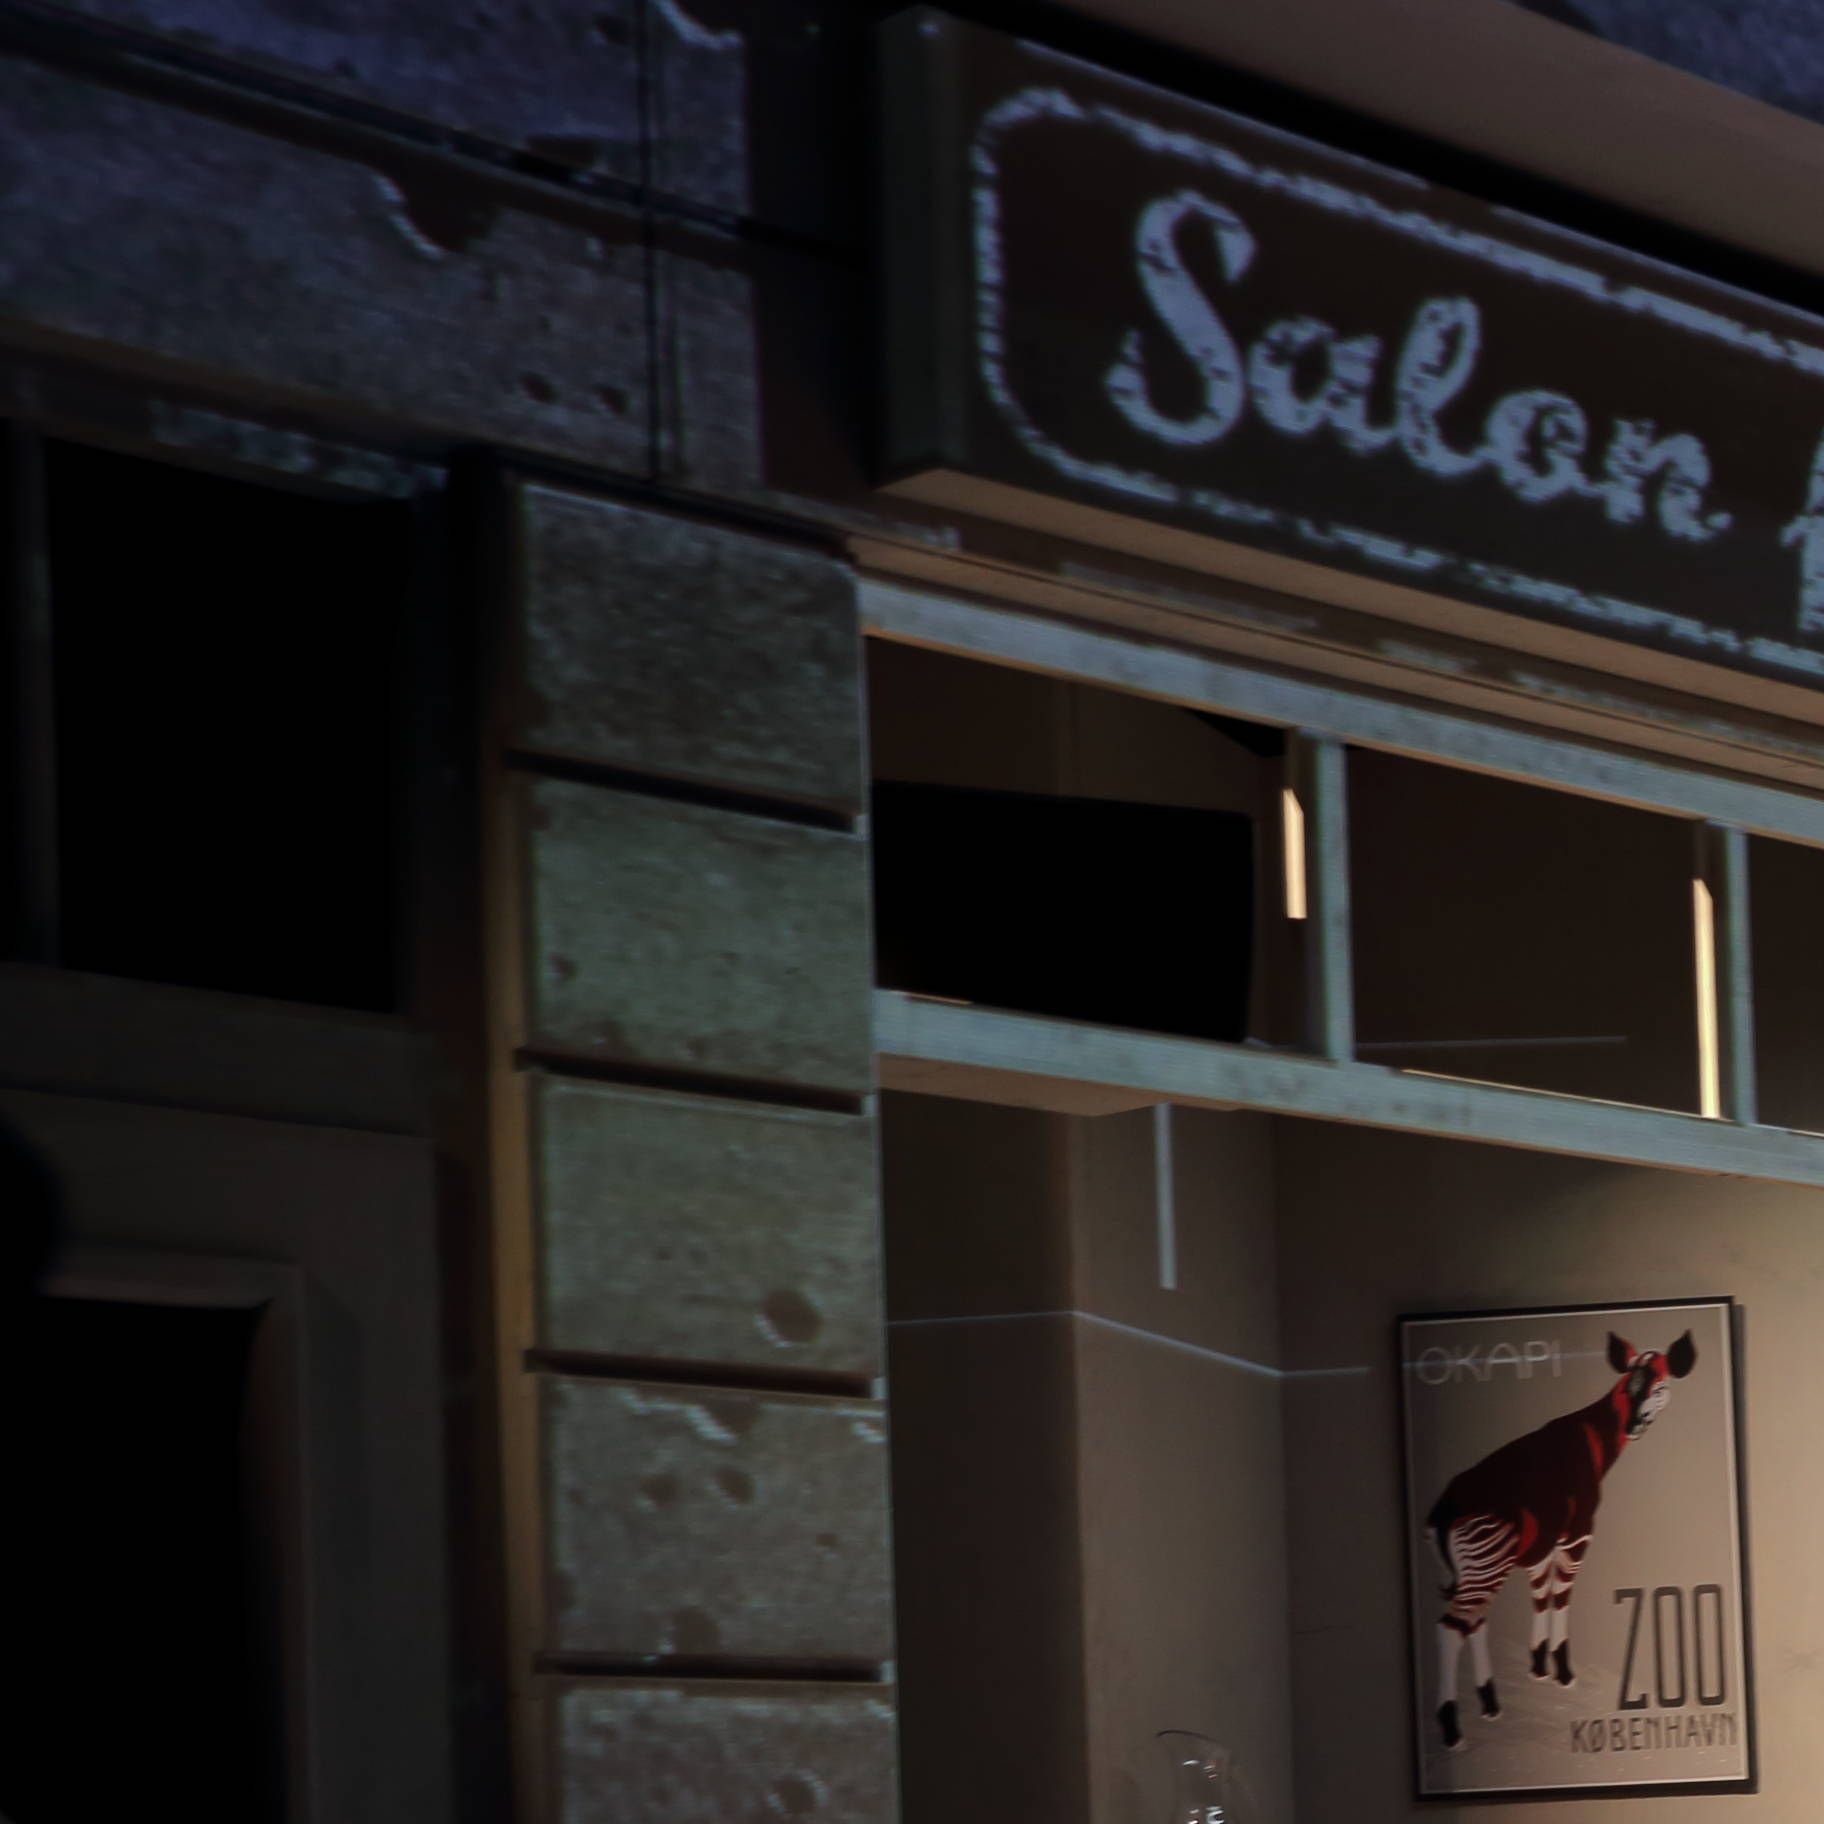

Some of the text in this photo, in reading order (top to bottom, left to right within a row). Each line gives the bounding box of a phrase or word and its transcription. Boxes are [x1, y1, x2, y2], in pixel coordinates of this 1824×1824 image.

[1103, 188, 1732, 542] Salon
[1416, 1340, 1562, 1385] OKAPI
[1614, 1583, 1727, 1711] ZOO
[1569, 1711, 1739, 1754] KØBENHAVN
